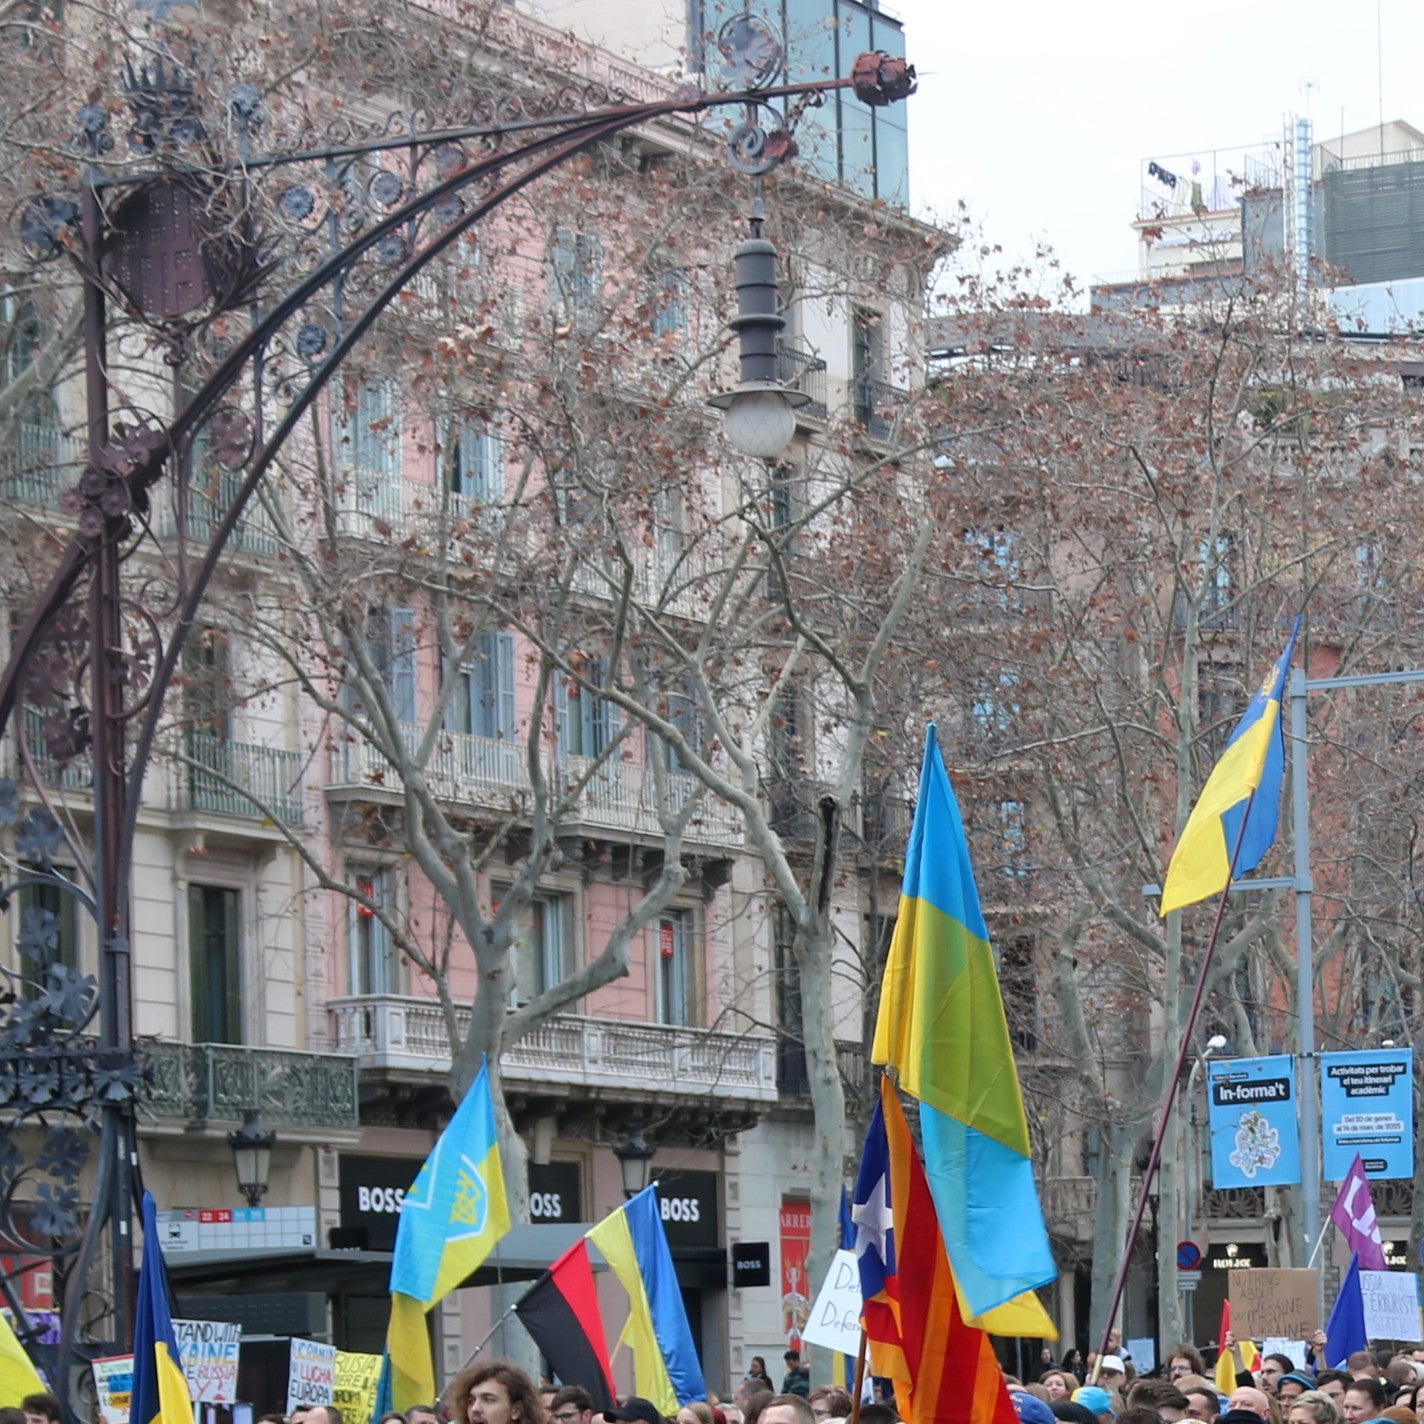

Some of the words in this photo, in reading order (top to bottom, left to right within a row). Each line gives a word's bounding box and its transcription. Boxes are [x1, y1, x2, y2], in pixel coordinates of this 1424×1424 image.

[1330, 1065, 1365, 1077] Activitats
[1365, 1066, 1380, 1077] per
[1381, 1064, 1404, 1075] trobar
[1350, 1077, 1362, 1085] teu
[1362, 1075, 1392, 1085] itinerari
[1219, 1081, 1286, 1101] In-forma't
[358, 1186, 405, 1214] BOSS
[530, 1193, 562, 1218] OSS
[201, 1211, 213, 1222] 22
[218, 1211, 230, 1222] 24
[660, 1198, 700, 1222] BOSS
[736, 1260, 762, 1270] BOSS
[1213, 1258, 1251, 1269] ROLEX
[290, 1379, 330, 1404] EUROPA
